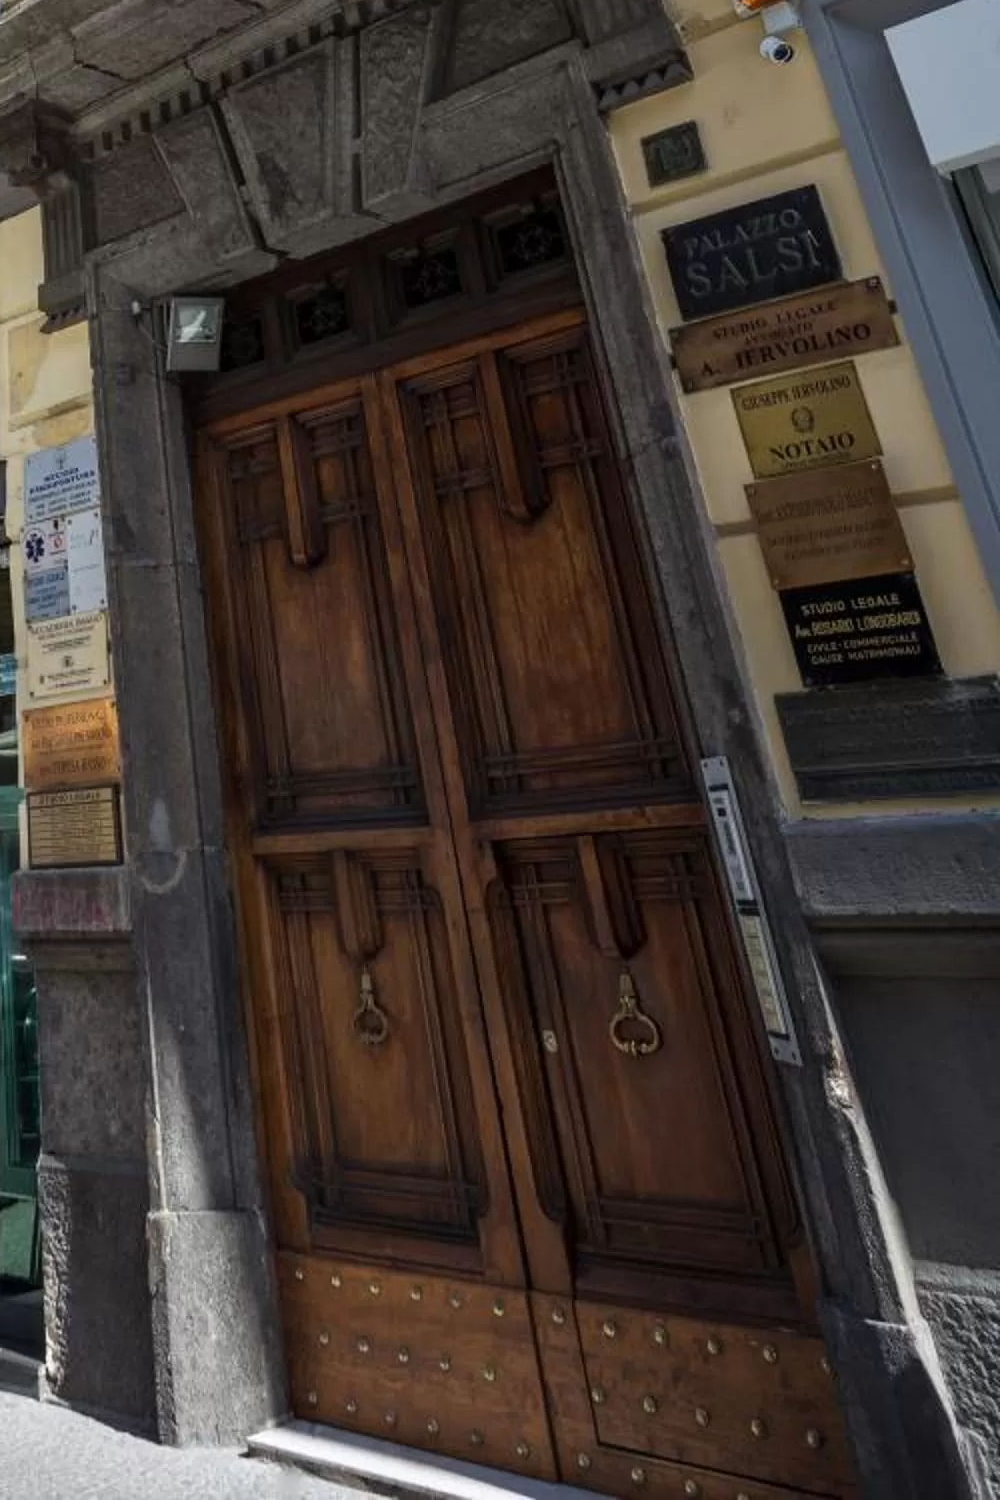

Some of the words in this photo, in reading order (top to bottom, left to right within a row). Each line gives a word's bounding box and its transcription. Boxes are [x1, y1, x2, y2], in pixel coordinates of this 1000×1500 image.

[684, 208, 802, 260] PALAZZO
[687, 229, 821, 297] SALSI
[734, 322, 872, 371] IERVOLINO
[769, 431, 856, 461] NOTAIO
[801, 600, 845, 617] STUDIO
[850, 593, 900, 609] LEGALE
